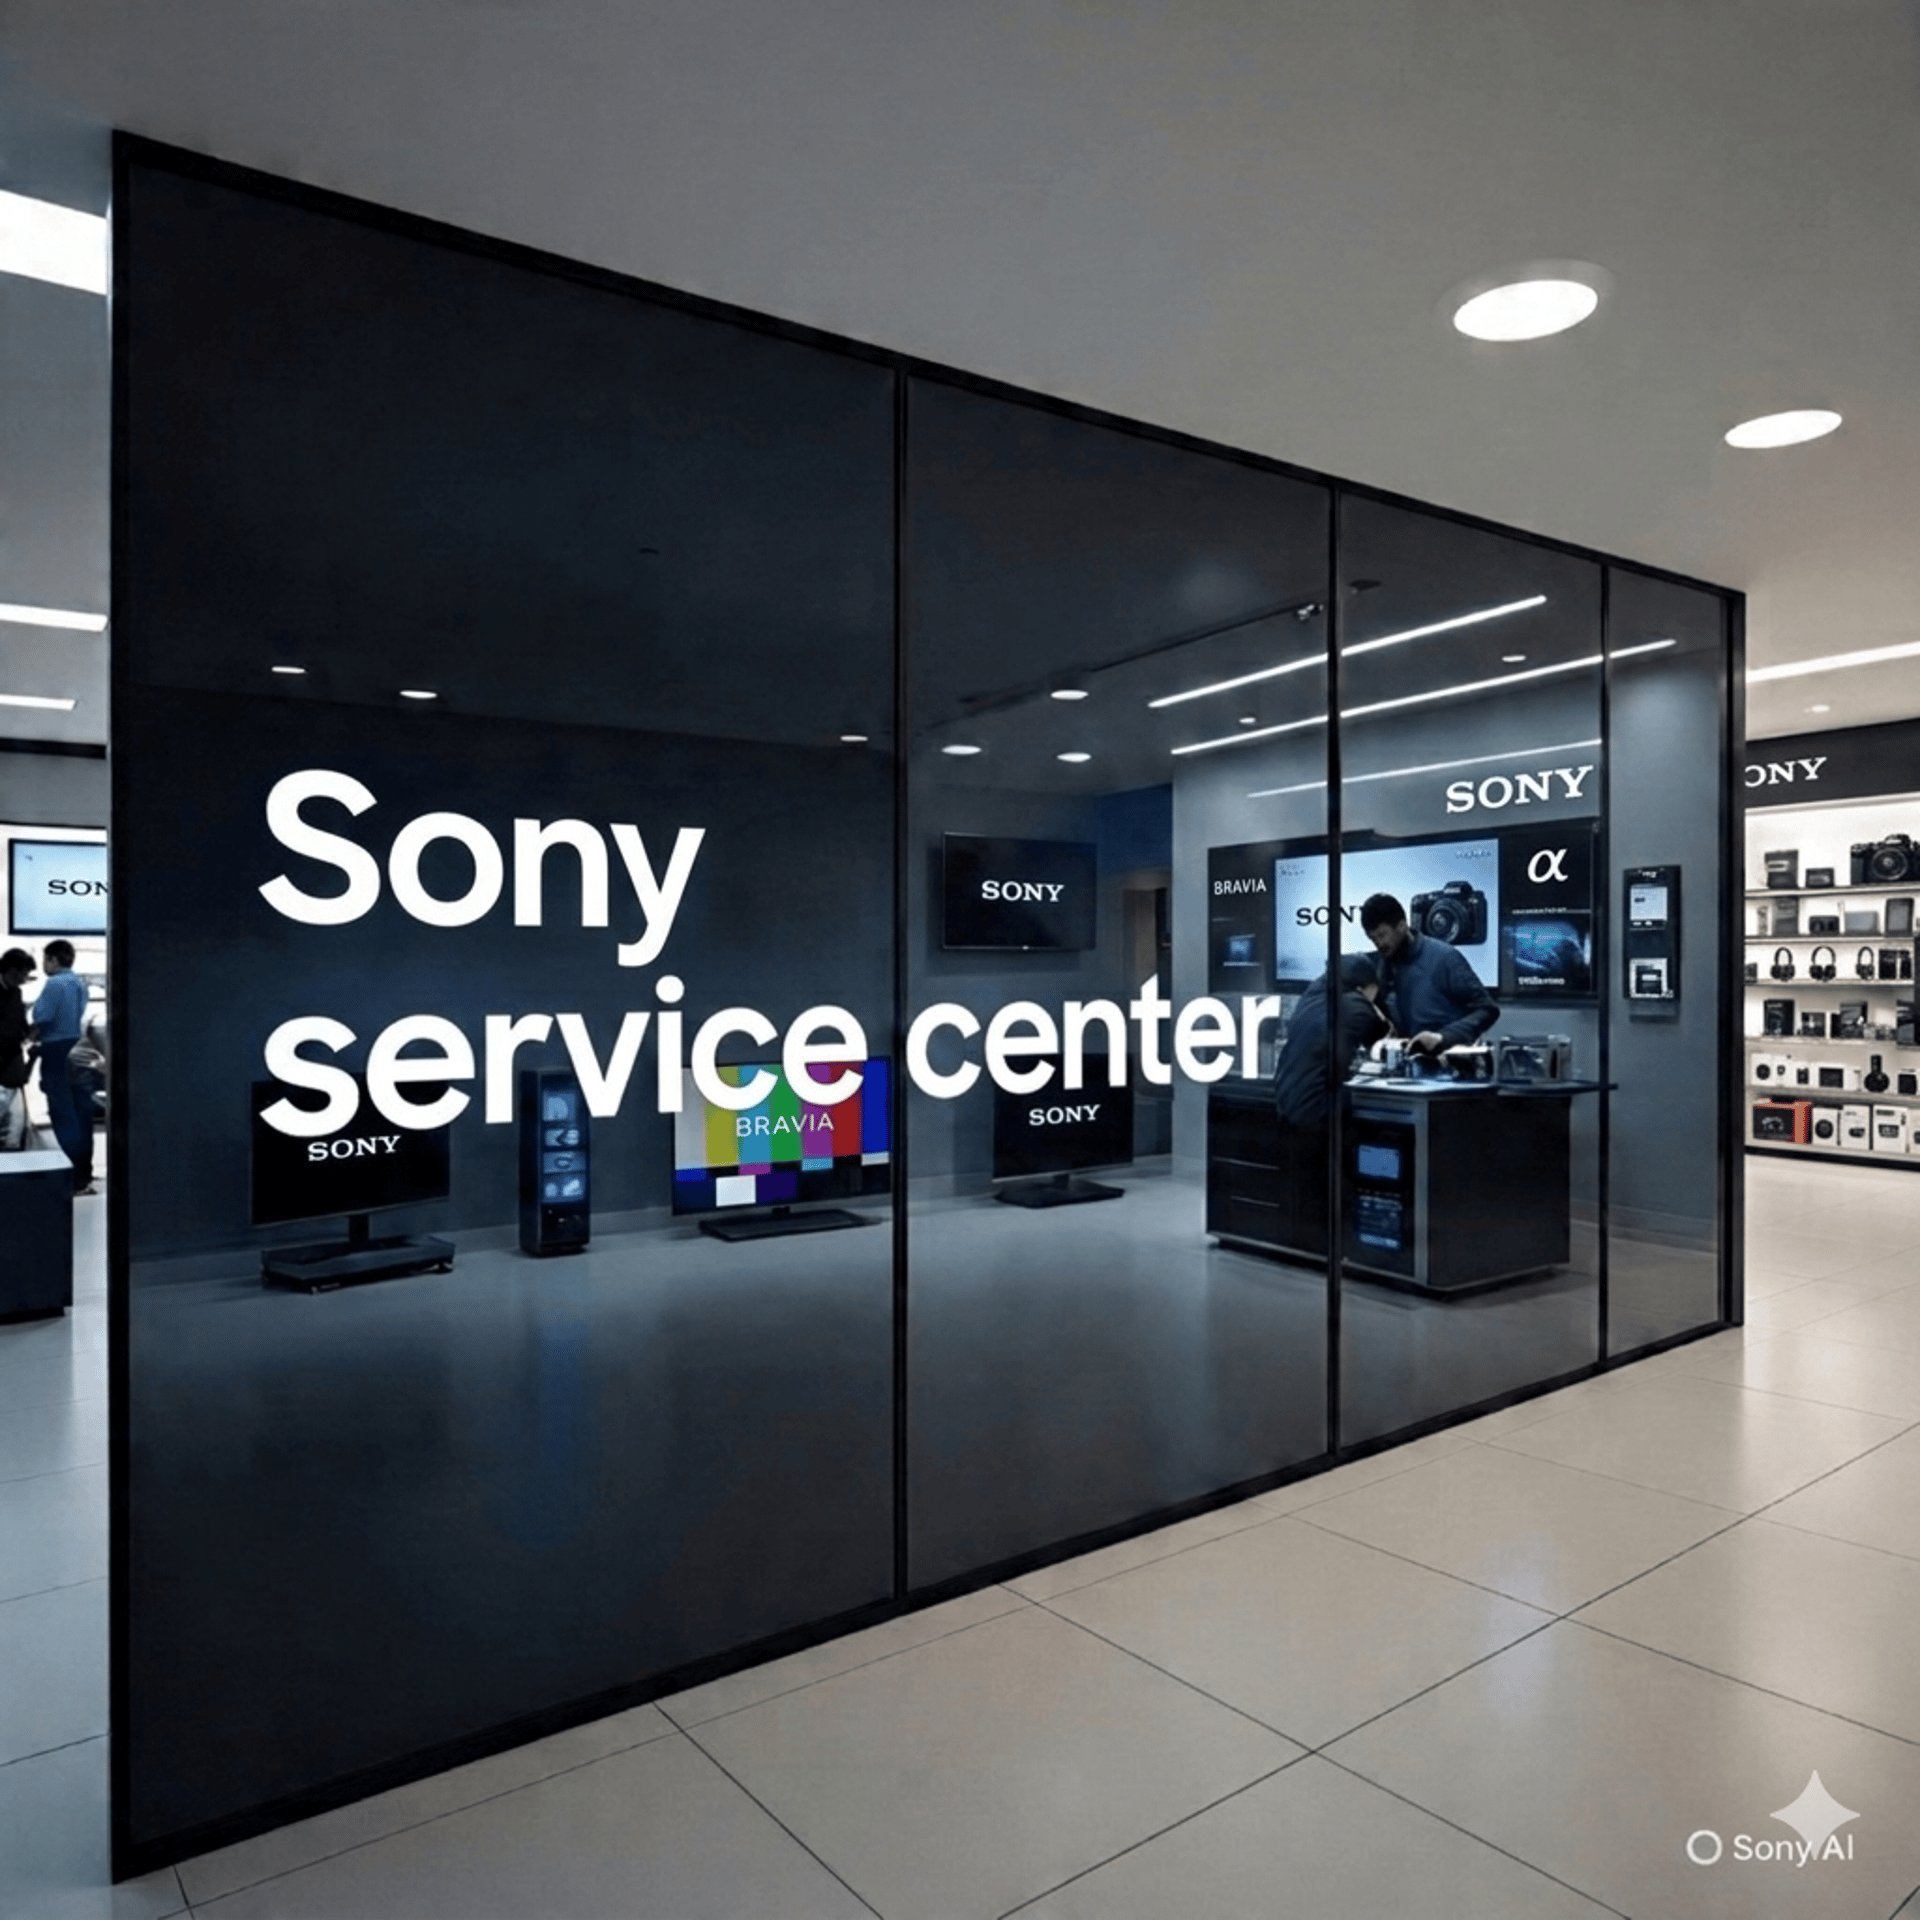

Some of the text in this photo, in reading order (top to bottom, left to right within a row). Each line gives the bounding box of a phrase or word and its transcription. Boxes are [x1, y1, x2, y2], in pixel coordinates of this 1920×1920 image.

[1446, 764, 1594, 814] SONY
[258, 769, 706, 967] Sony
[981, 880, 1064, 903] SONY
[1213, 877, 1267, 896] BRAVIA
[1296, 905, 1364, 927] SON
[259, 972, 1280, 1139] service center
[735, 1111, 834, 1138] BRAVIA
[1029, 1104, 1100, 1126] SONY
[307, 1134, 401, 1162] SONY
